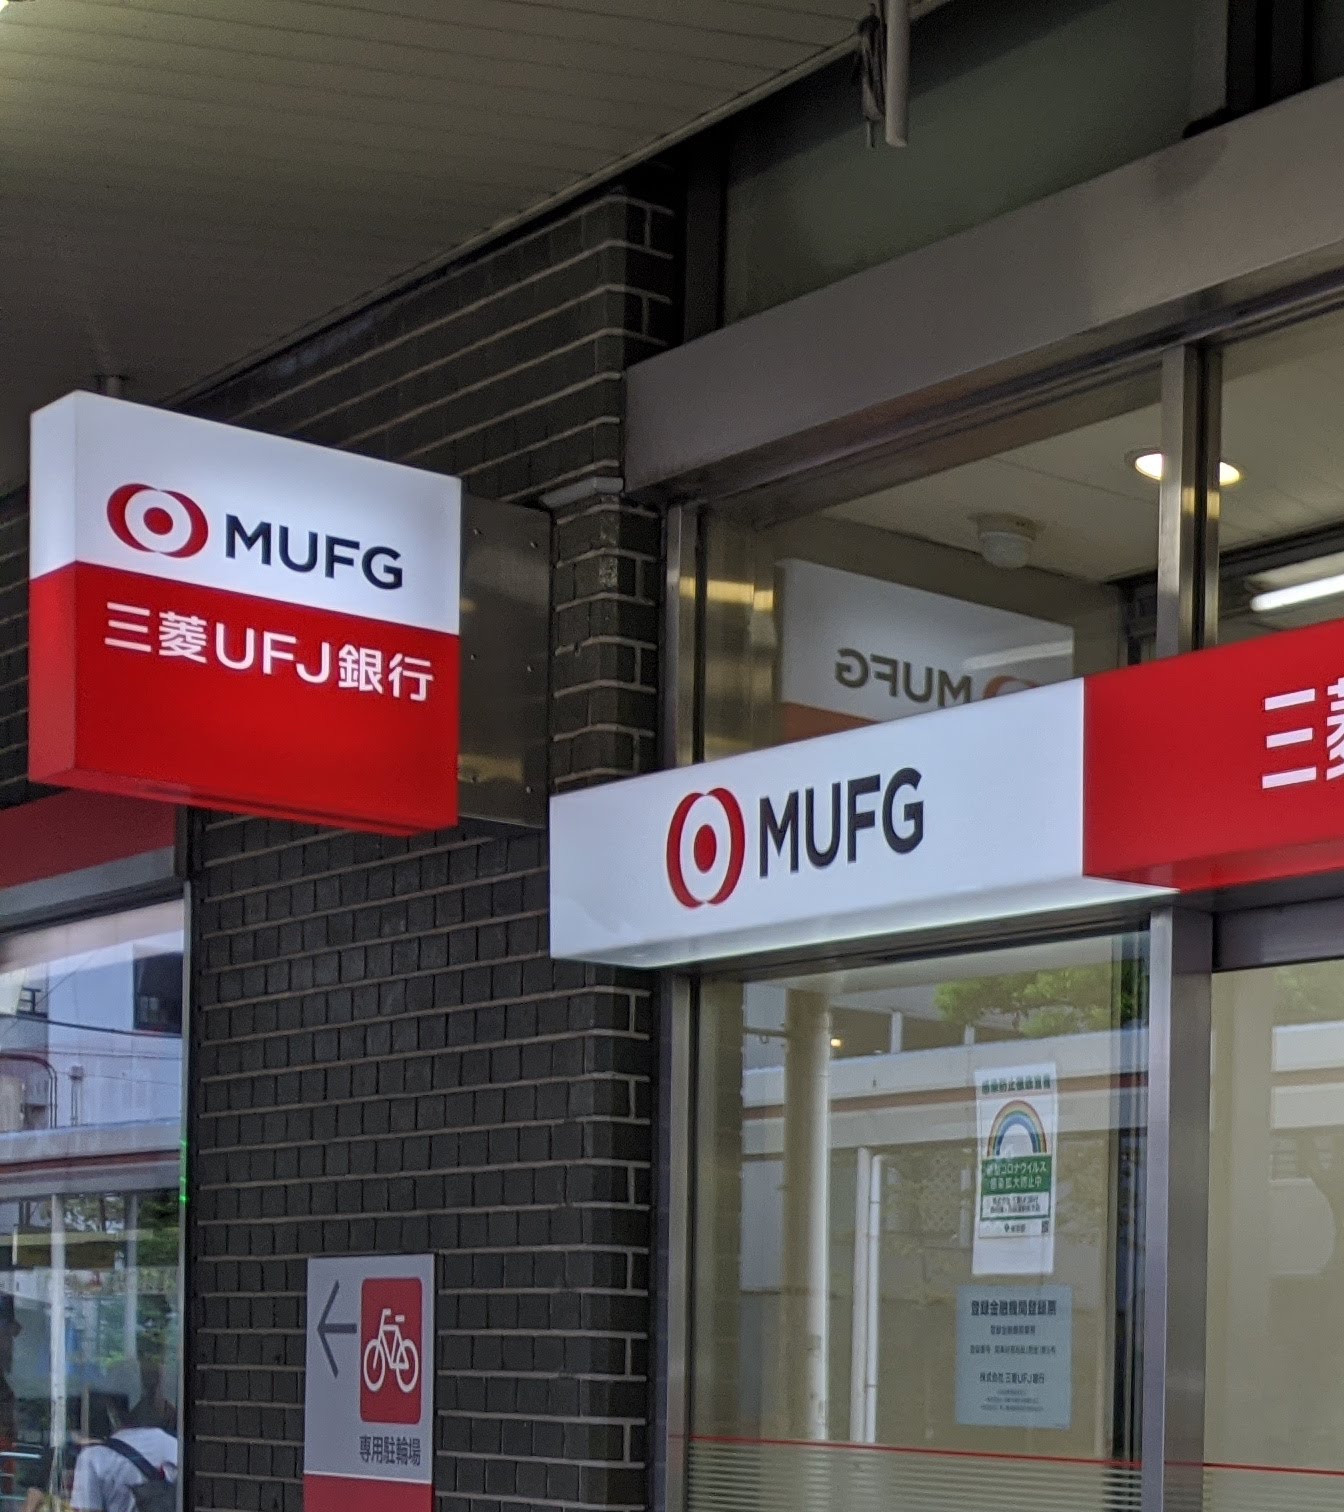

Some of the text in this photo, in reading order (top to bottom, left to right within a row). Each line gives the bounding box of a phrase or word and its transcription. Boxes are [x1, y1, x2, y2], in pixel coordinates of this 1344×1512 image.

[225, 513, 403, 590] MUFG
[104, 602, 434, 702] 三菱UFJ銀行
[758, 766, 925, 881] MUFG
